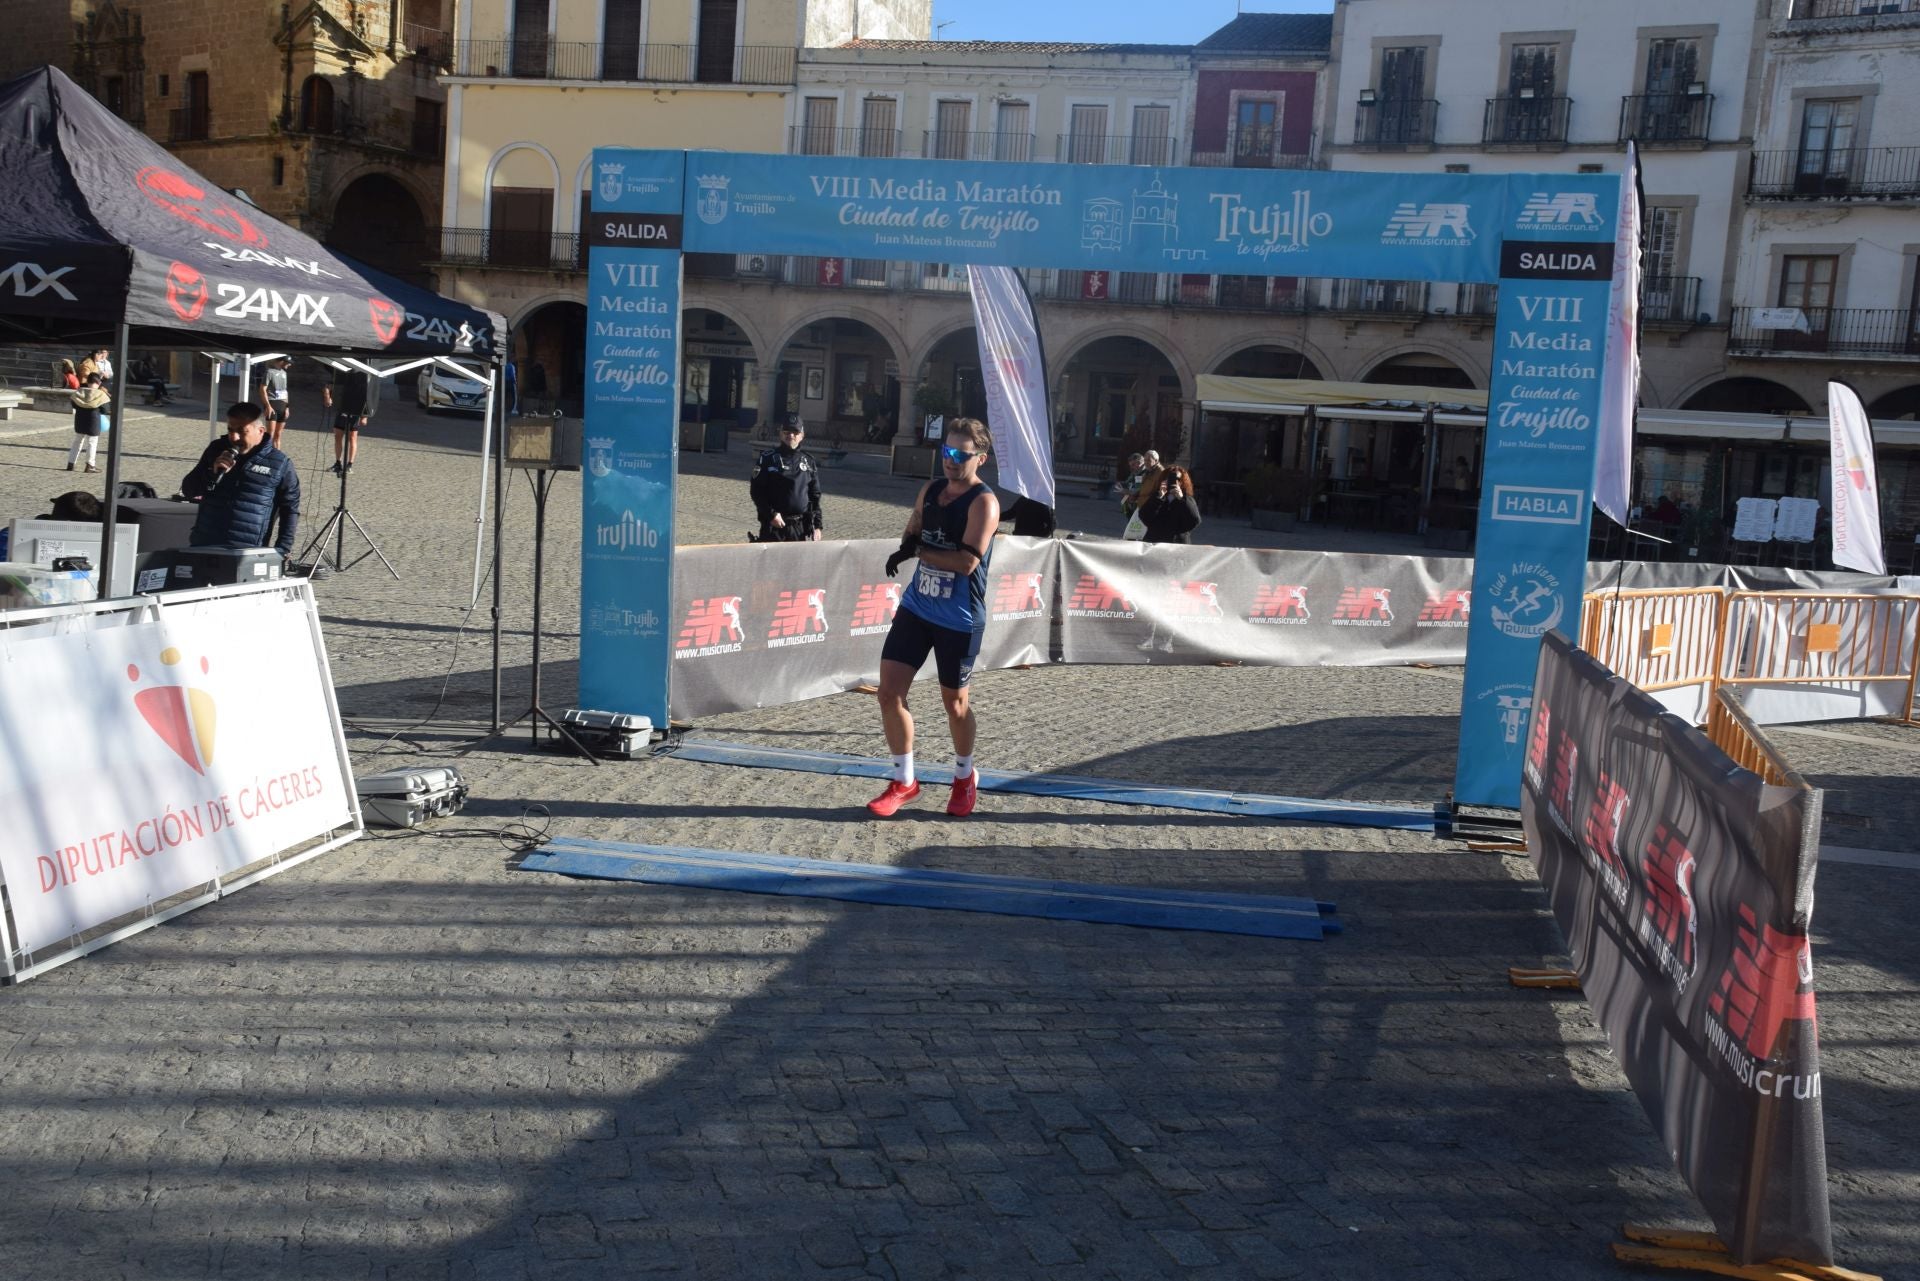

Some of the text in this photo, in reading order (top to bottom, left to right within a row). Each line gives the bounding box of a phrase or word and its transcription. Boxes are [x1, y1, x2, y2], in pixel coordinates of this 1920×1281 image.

[627, 183, 660, 193] Trujillo
[810, 175, 1063, 206] VIII Media Maratón
[734, 192, 796, 203] Ayuntamiento de
[734, 202, 775, 216] Trujillo
[839, 203, 1040, 240] Ciudad de Trujillo
[1209, 190, 1333, 247] Trujillo
[1516, 222, 1599, 232] www.musicrun.es
[605, 223, 668, 240] SALIDA
[874, 233, 997, 249] Juan Mateos Broncano
[1380, 237, 1471, 247] www.musicrun.es
[1519, 252, 1596, 271] SALIDA
[605, 263, 660, 288] VIII
[215, 284, 335, 327] 24MX
[600, 295, 668, 314] Media
[1517, 296, 1583, 322] VIII
[595, 321, 672, 339] Maratón
[1509, 331, 1592, 351] Media
[603, 343, 660, 359] Ciudad de
[593, 360, 668, 392] Trujillo
[1501, 359, 1596, 379] Maratón
[1511, 385, 1581, 401] Ciudad de
[1498, 402, 1590, 438] Trujillo
[1499, 440, 1585, 451] Juan Mateos Broncano
[618, 459, 652, 470] Trujillo
[1506, 496, 1568, 513] HABLA
[597, 509, 657, 551] trujillo
[1488, 560, 1559, 596] Club Atletismo
[993, 609, 1042, 622] www.musicrun.es
[1066, 608, 1135, 619] www.musicrun.es
[1248, 616, 1308, 626] www.musicrun.es
[1332, 618, 1391, 627] www.musicrun.es
[768, 632, 825, 649] www.musicrun.es
[675, 642, 742, 659] www.musicrun.es
[37, 766, 323, 893] DIPUTACIÓN DE CÁCERES
